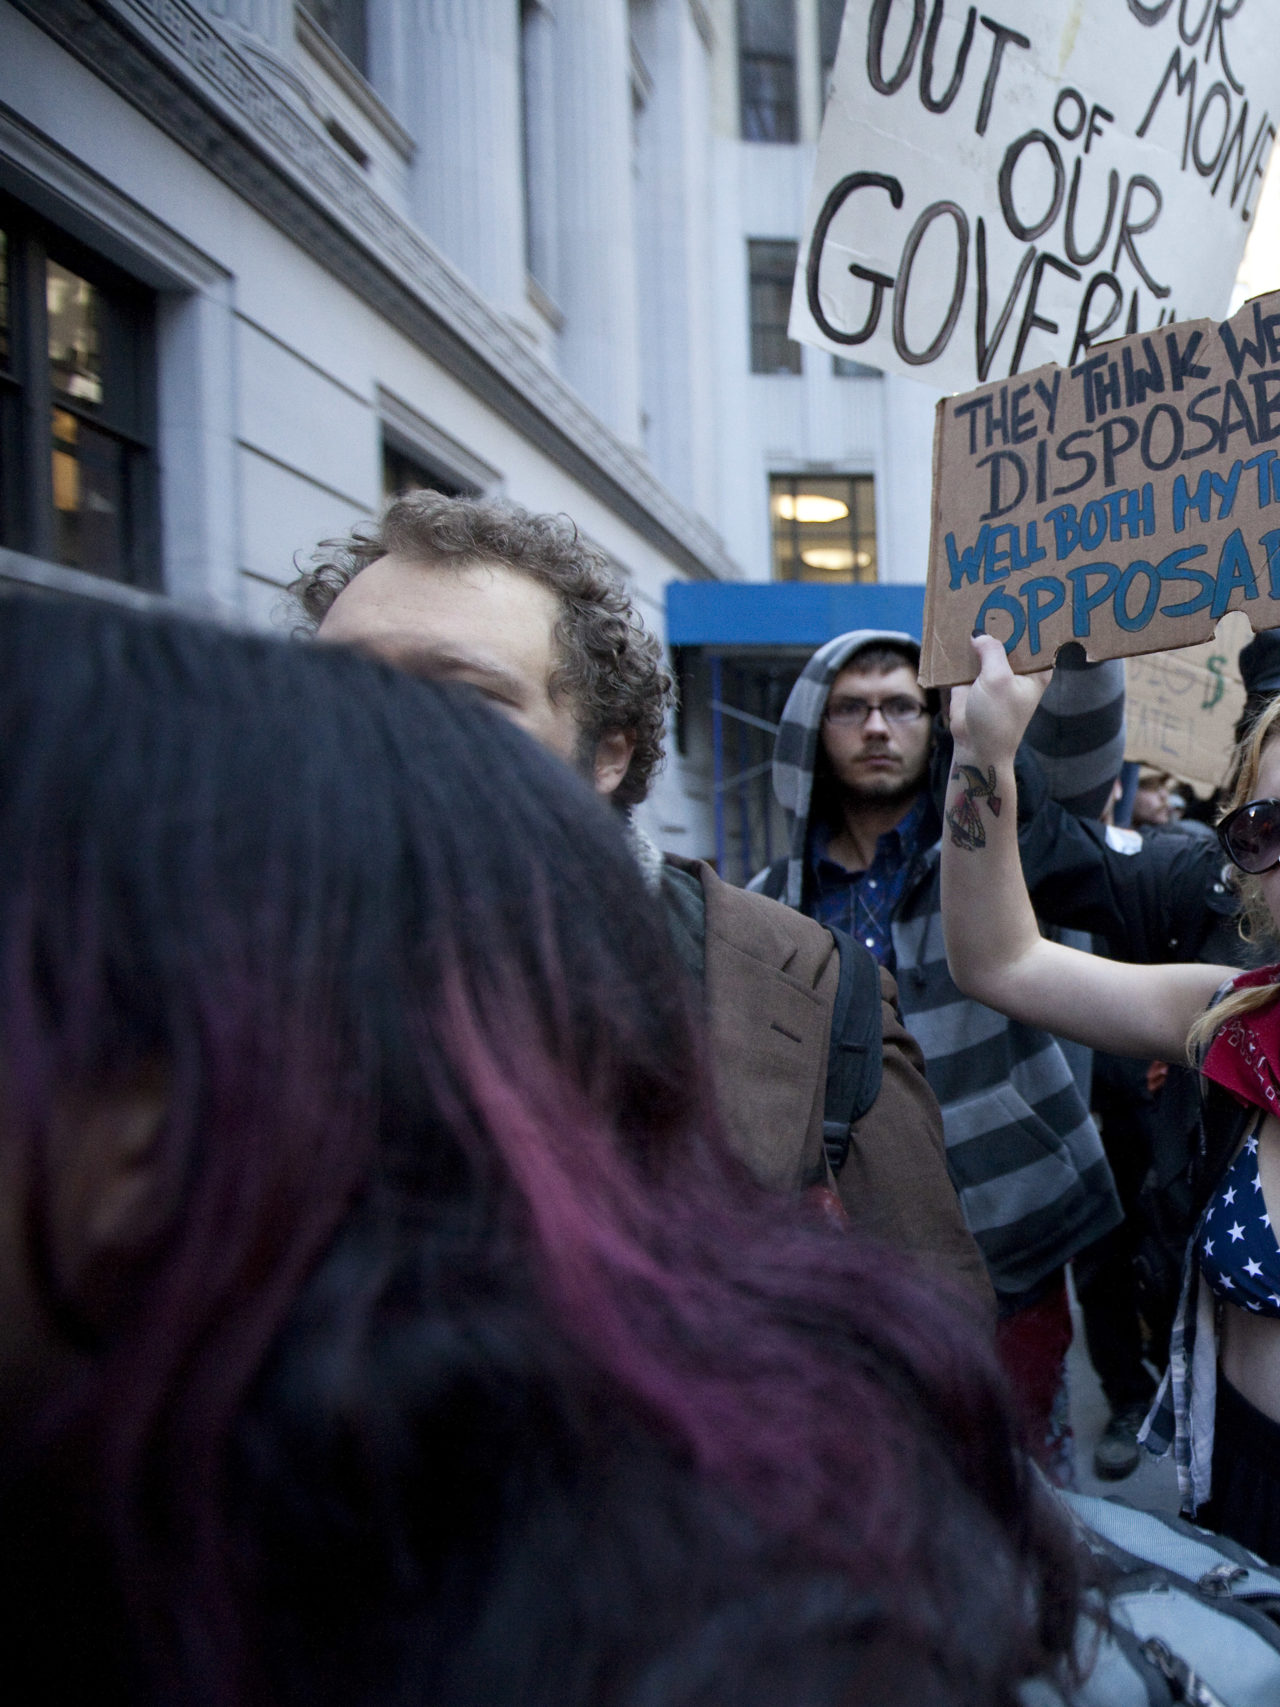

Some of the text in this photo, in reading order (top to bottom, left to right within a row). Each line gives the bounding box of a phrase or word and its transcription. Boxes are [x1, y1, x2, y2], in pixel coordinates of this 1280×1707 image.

[866, 0, 1114, 153] OUT OF
[999, 129, 1171, 299] OUR
[954, 370, 1061, 455] THEY
[1071, 330, 1213, 424] THINK
[945, 522, 1047, 592] WELL
[1044, 483, 1156, 561] BOTH
[1172, 459, 1242, 532] MY
